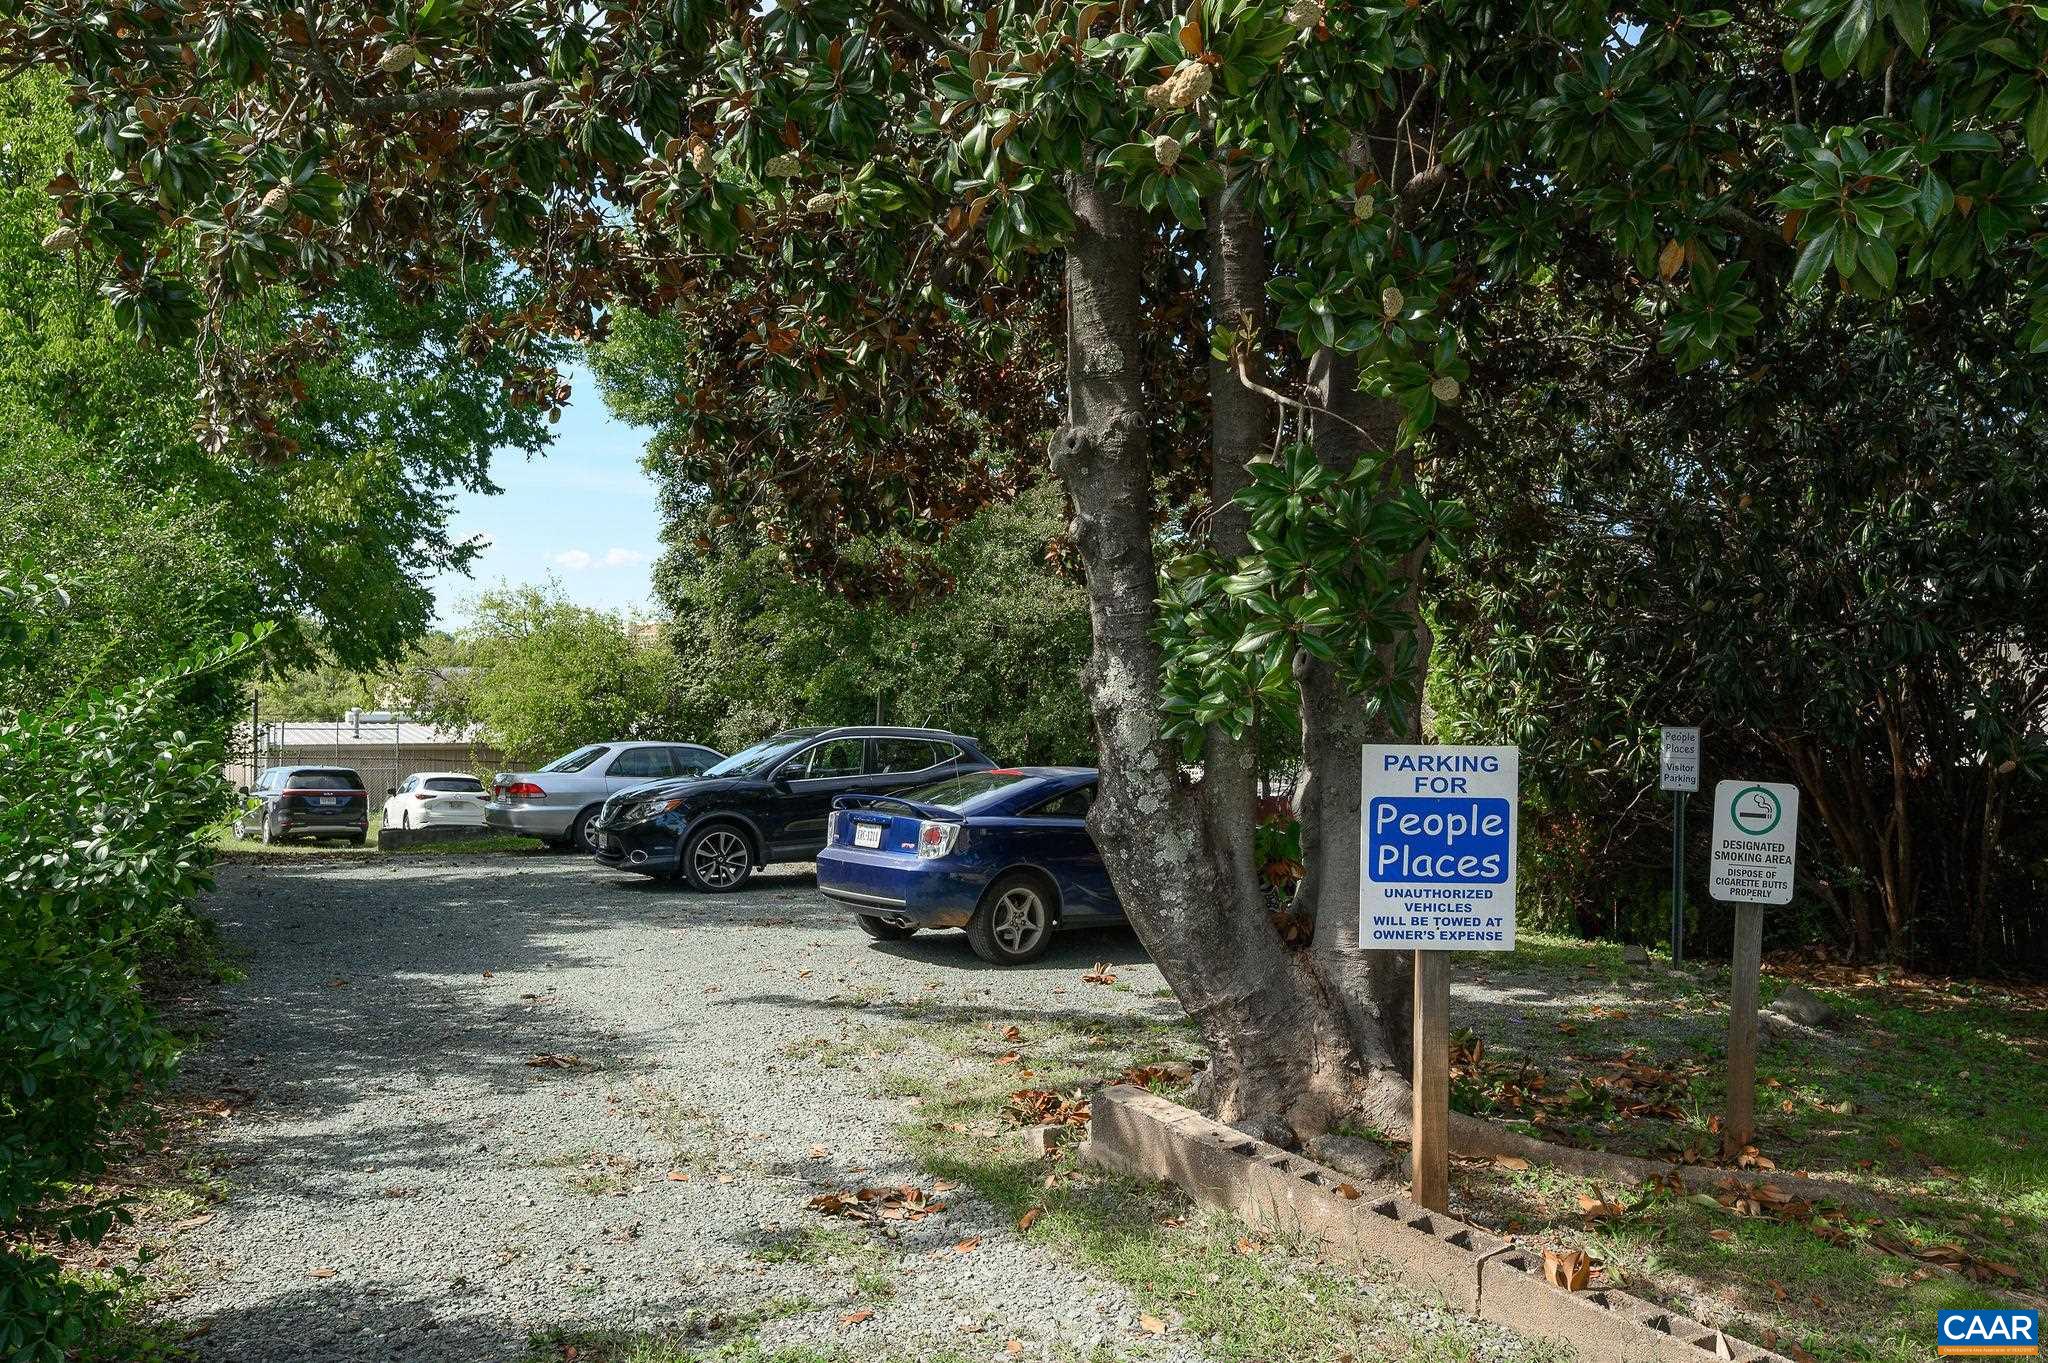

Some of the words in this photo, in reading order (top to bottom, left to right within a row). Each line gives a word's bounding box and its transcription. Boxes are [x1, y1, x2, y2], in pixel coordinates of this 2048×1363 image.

[1665, 731, 1696, 743] People
[1665, 743, 1696, 754] Places
[1384, 755, 1499, 773] PARKING
[1666, 762, 1695, 772] Visitor
[1414, 776, 1468, 794] FOR
[1664, 773, 1696, 785] Parking
[1376, 803, 1504, 846] People
[1723, 839, 1785, 853] DESIGNATED
[1378, 844, 1501, 878] Places
[1714, 850, 1762, 863] SMOKING
[1765, 854, 1792, 865] AREA
[1727, 868, 1763, 879] DISPOSE
[1765, 871, 1777, 879] OF
[1715, 877, 1760, 888] CIGARETTE
[1762, 880, 1788, 890] BUTTS
[1384, 888, 1493, 899] UNAUTHORIZED
[1729, 887, 1772, 898] PROPERLY
[1404, 902, 1473, 913] VEHICLES
[1373, 916, 1407, 926] WILL
[1410, 916, 1429, 927] BE
[1433, 917, 1482, 927] TOWED
[1485, 917, 1504, 927] AT
[1373, 930, 1436, 940] OWNER'S
[1439, 931, 1503, 941] EXPENSE
